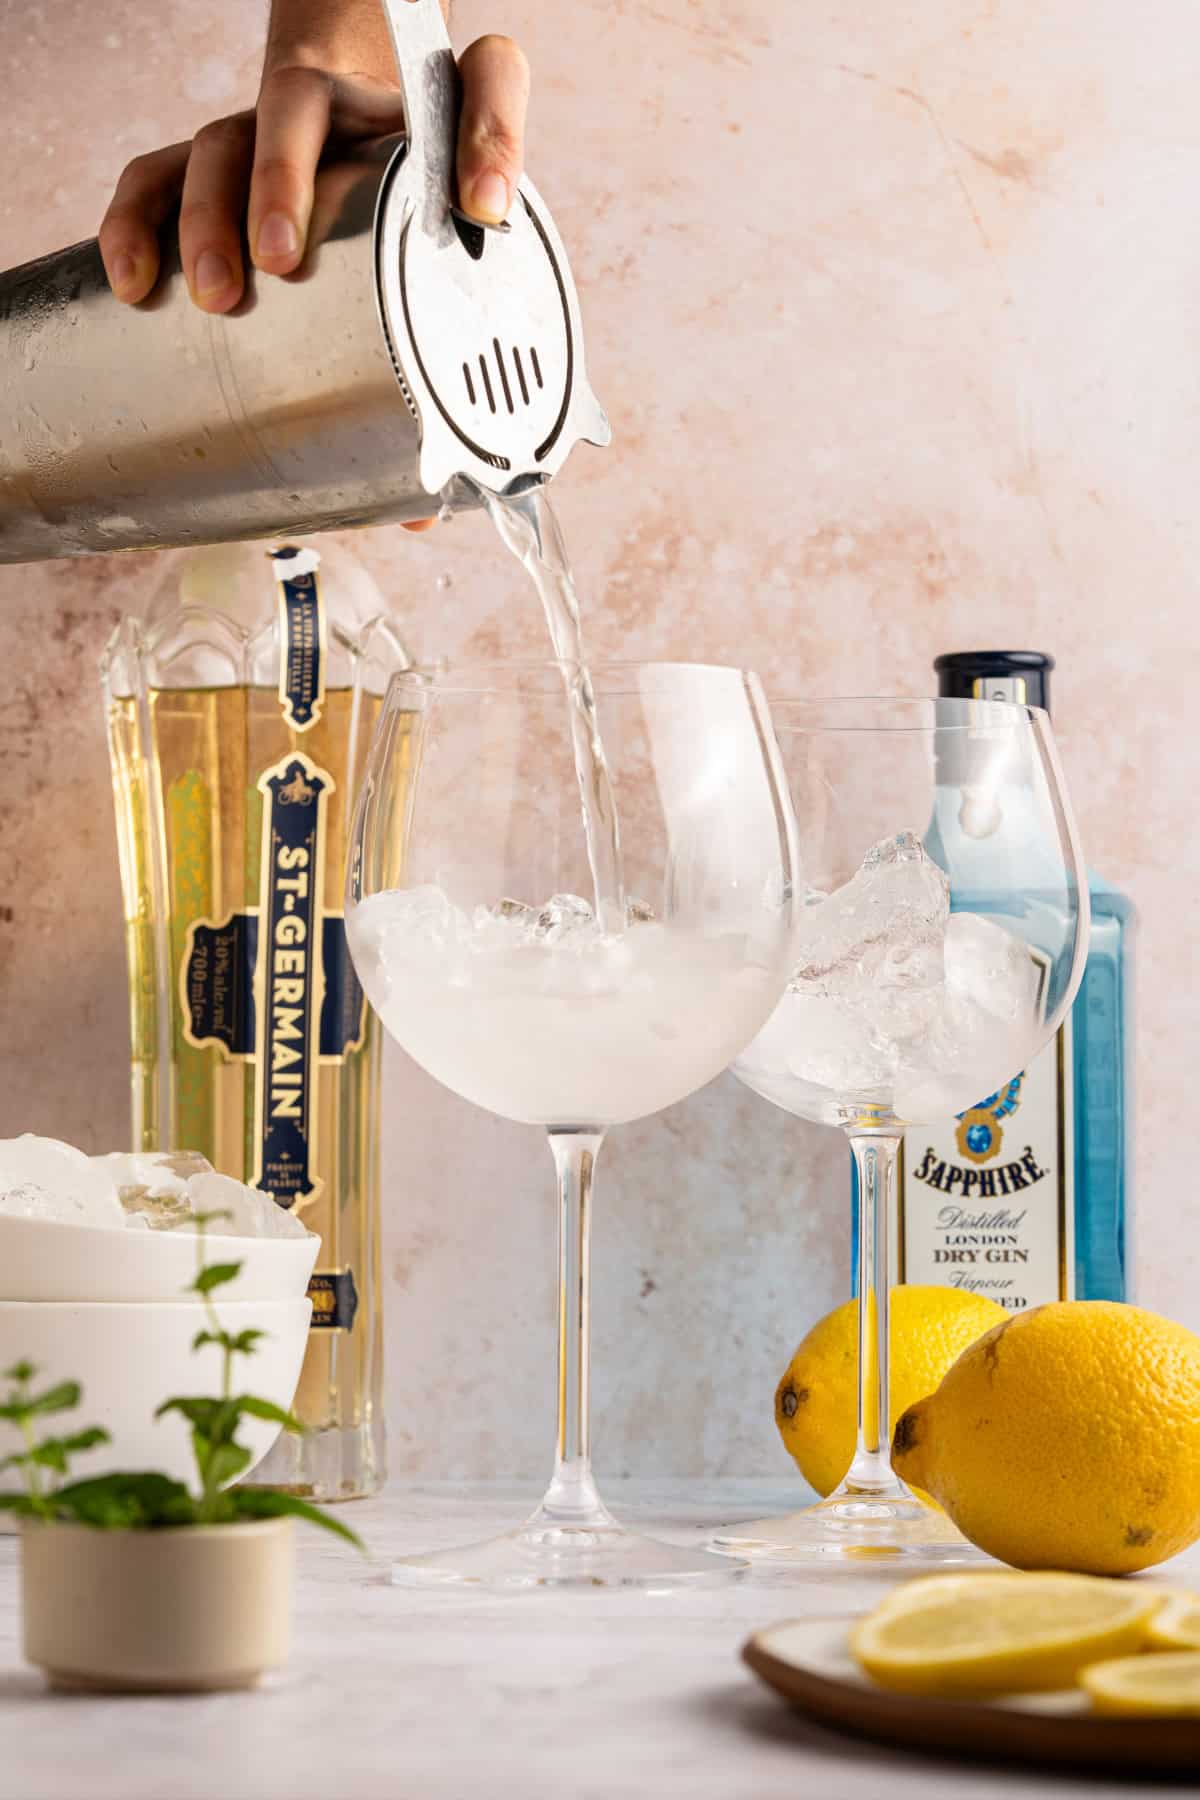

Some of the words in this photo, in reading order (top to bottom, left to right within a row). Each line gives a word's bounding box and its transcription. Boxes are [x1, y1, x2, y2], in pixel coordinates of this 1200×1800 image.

[913, 1146, 1046, 1198] SAPPHIRE
[935, 1206, 1027, 1230] Distilled
[945, 1235, 1018, 1245] LONDON
[934, 1250, 981, 1263] DRY
[985, 1250, 1029, 1263] GIN
[948, 1270, 1014, 1292] Vapour
